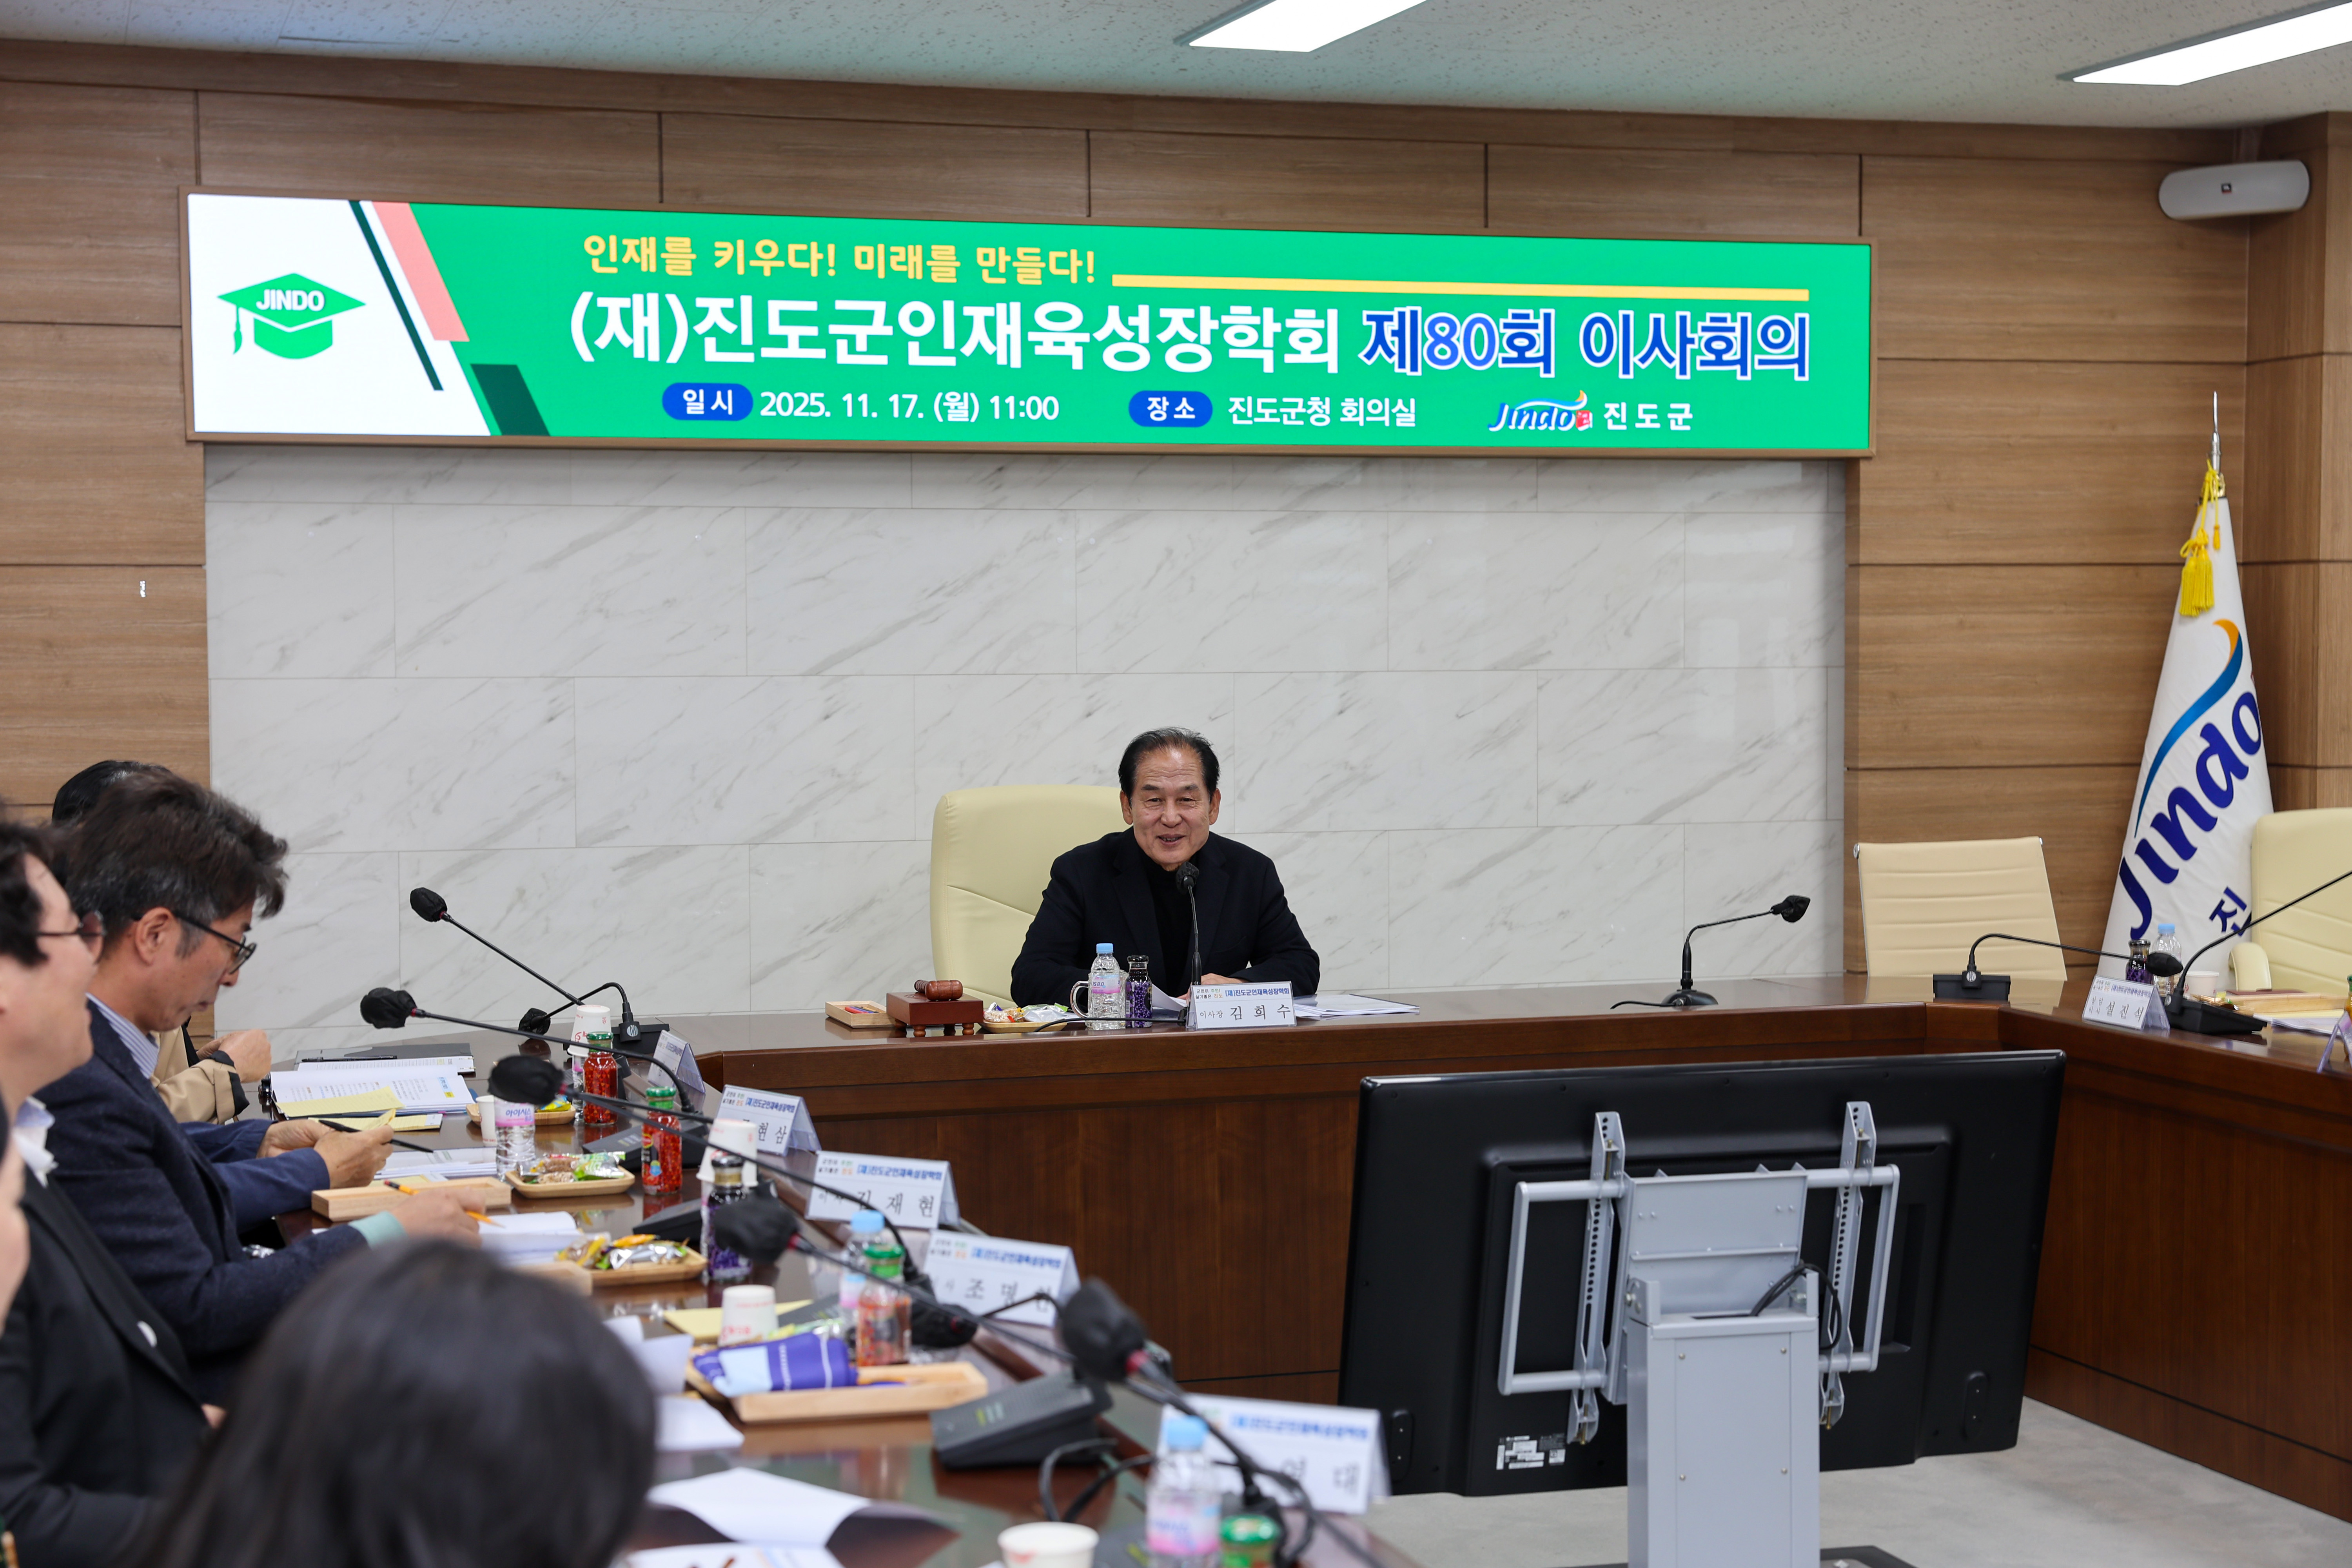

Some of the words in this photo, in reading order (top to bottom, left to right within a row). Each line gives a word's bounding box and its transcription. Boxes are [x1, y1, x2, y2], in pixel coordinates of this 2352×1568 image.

[584, 235, 697, 276] 인재를
[715, 239, 836, 277] 키우다!
[855, 244, 961, 283] 미래를
[976, 247, 1095, 285] 만들다!
[256, 289, 325, 312] JINDO
[571, 291, 1339, 373] (재)진도군인재육성장학회
[1358, 306, 1555, 378] 제80회
[1579, 310, 1810, 381] 이사회의
[760, 392, 831, 417] 2025.
[842, 393, 877, 417] 11.
[889, 394, 924, 418] 17.
[934, 392, 979, 422] (월)
[990, 396, 1059, 420] 11:00
[1229, 396, 1331, 426] 진도군청
[1340, 397, 1415, 426] 회의실
[1488, 403, 1576, 431] Jindo
[2119, 692, 2261, 939] Jindo
[1200, 1010, 1223, 1019] 이사장
